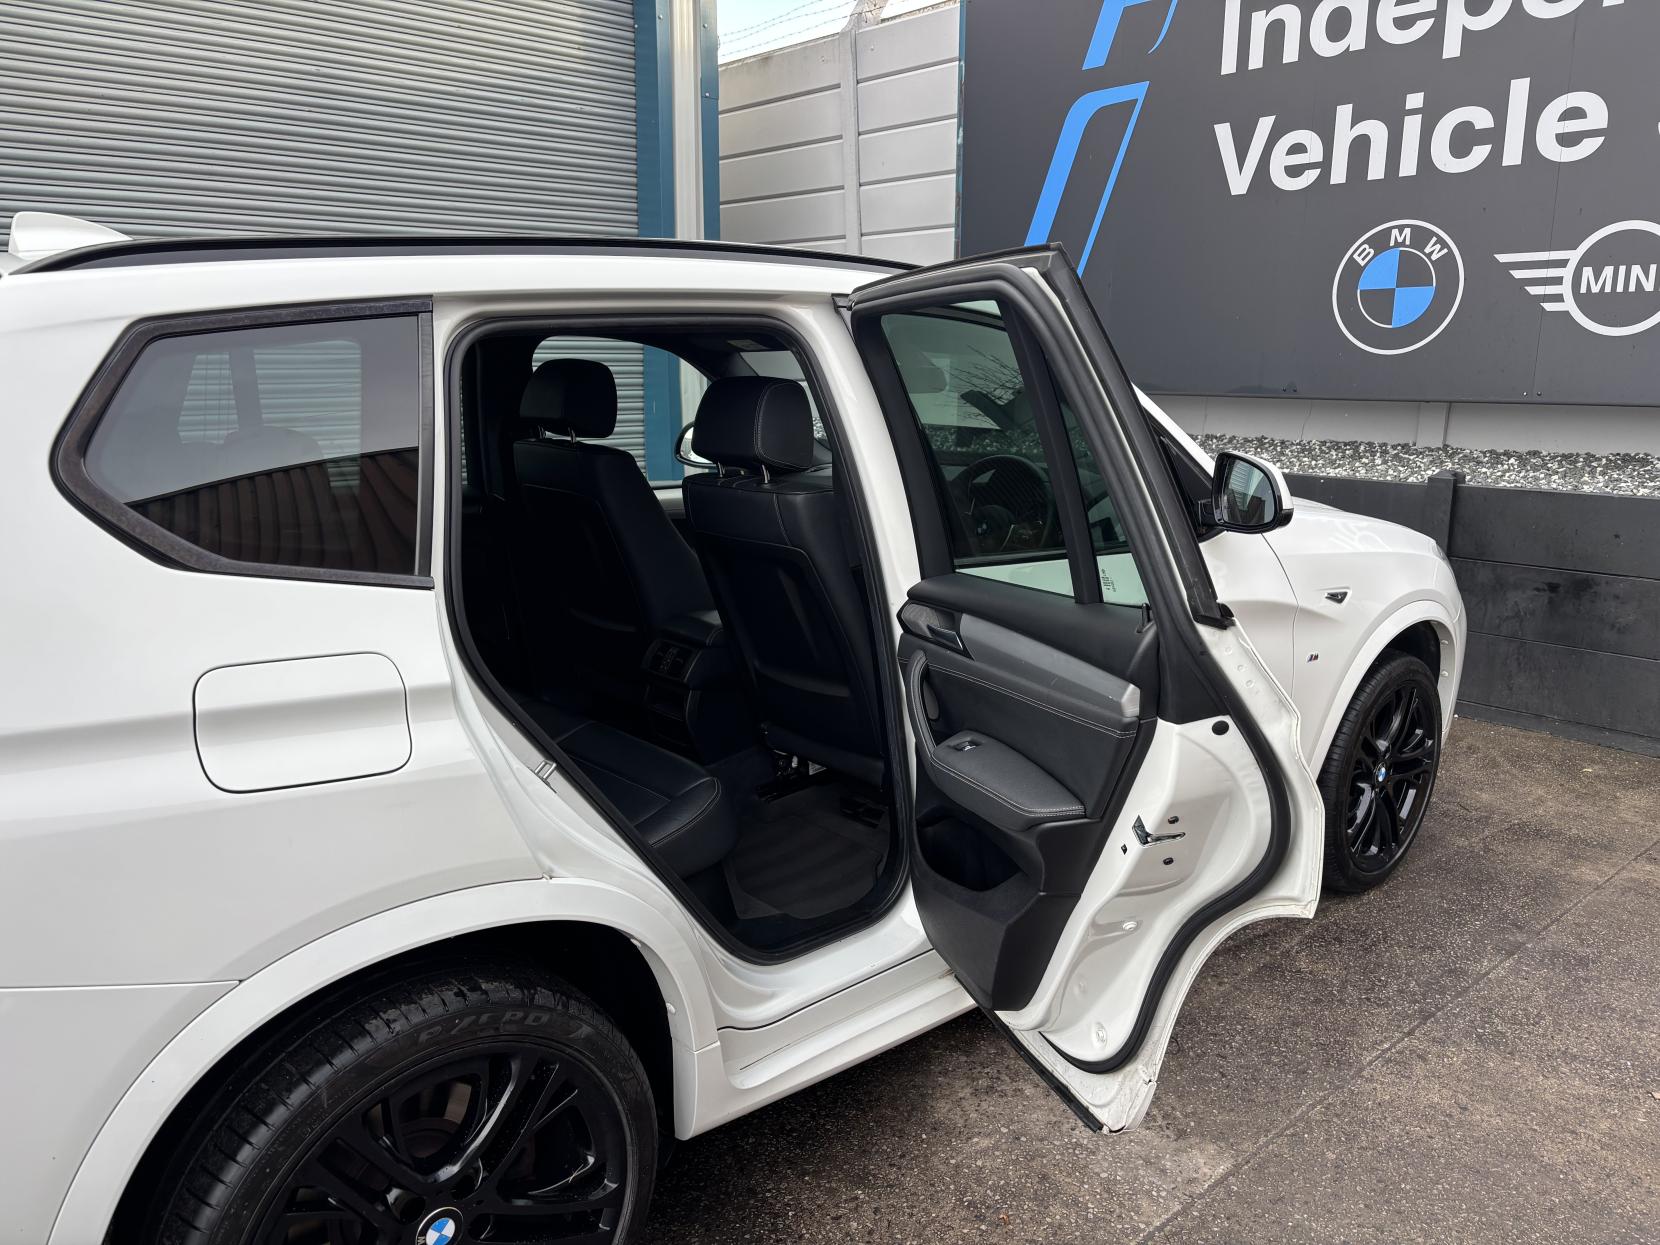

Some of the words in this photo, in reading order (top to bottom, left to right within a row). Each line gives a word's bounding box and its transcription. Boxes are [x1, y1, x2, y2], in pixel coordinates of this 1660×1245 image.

[1220, 0, 1625, 76] Indep
[1213, 77, 1609, 196] Vehicle
[1352, 227, 1449, 267] BMW
[1579, 263, 1660, 294] MIN
